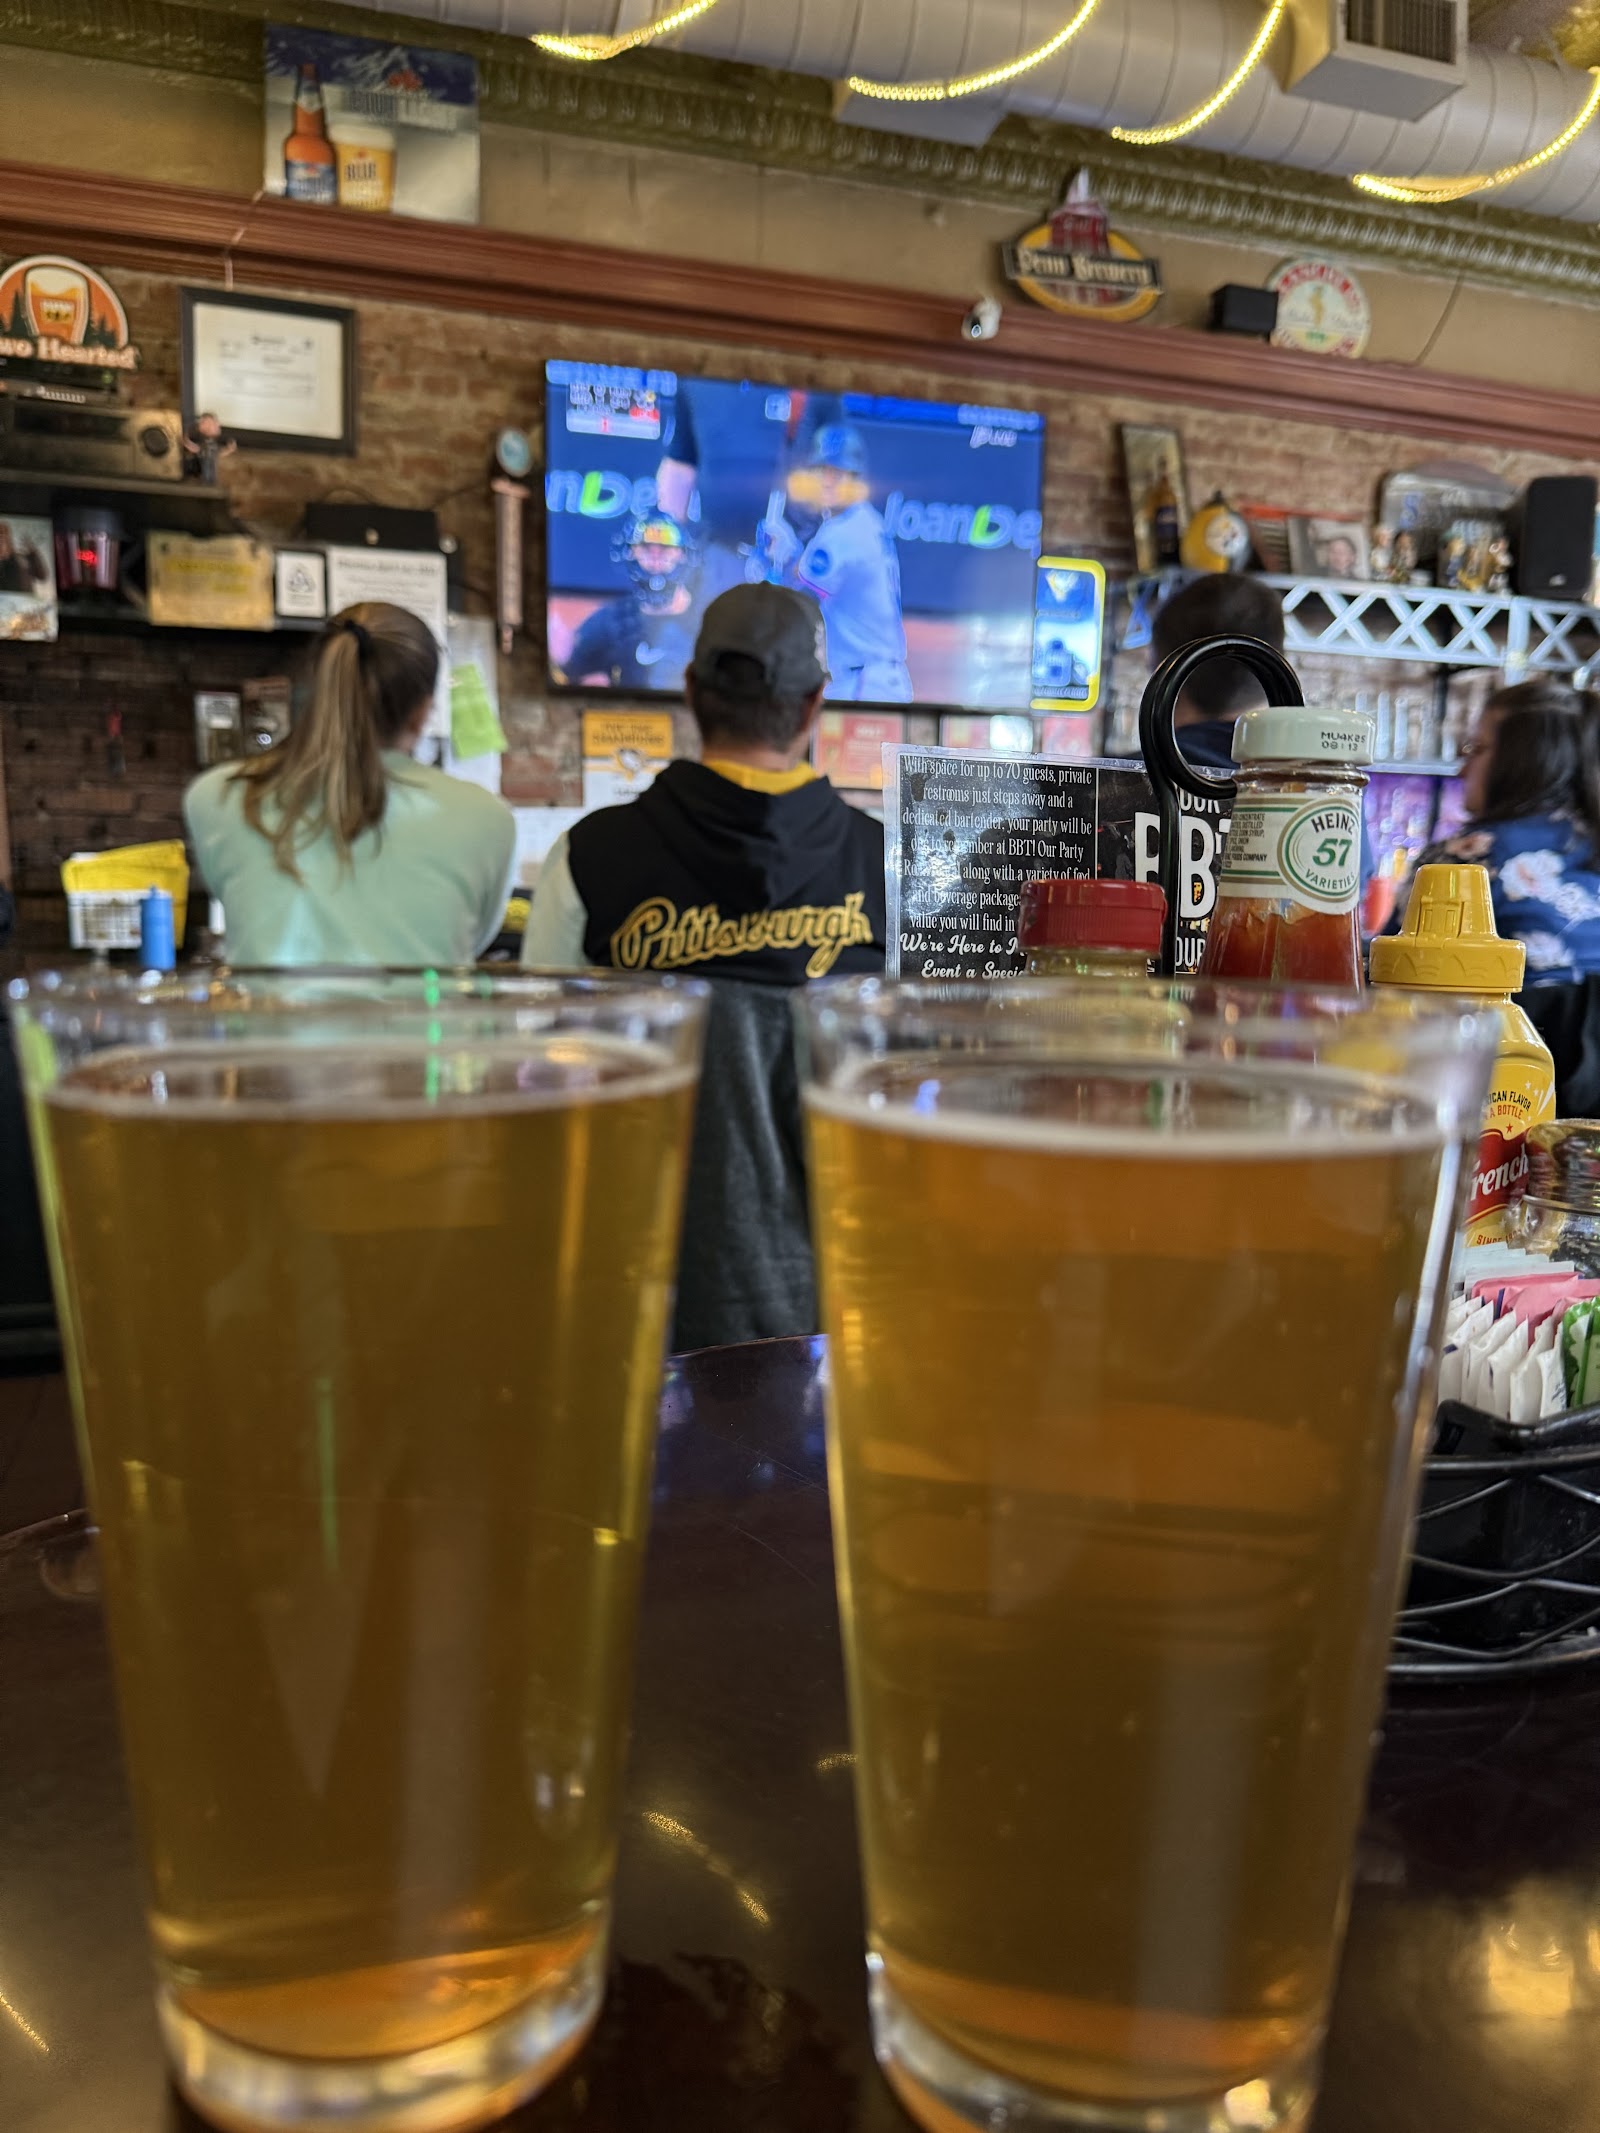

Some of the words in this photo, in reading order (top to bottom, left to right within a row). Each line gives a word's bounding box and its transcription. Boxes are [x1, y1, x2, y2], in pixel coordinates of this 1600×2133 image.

[37, 336, 139, 370] Hearted
[904, 756, 928, 774] With
[930, 761, 958, 779] space
[960, 760, 975, 777] for
[977, 764, 990, 782] up
[993, 763, 1003, 779] to
[1005, 763, 1020, 780] 70
[1023, 767, 1056, 784] guests,
[1058, 768, 1092, 786] private
[923, 784, 969, 803] restrooms
[971, 787, 991, 806] just
[993, 788, 1020, 807] steps
[1021, 793, 1046, 810] away
[1047, 790, 1065, 808] and
[1067, 796, 1073, 808] a
[903, 807, 951, 828] dedicated
[1007, 816, 1030, 835] your
[1032, 817, 1058, 836] party
[1060, 816, 1079, 834] will
[1081, 816, 1092, 835] be
[1311, 812, 1355, 835] HEINZ
[996, 840, 1006, 855] at
[1008, 838, 1036, 856] BBT!
[1038, 840, 1057, 857] Our
[1059, 841, 1084, 861] Party
[1312, 837, 1353, 867] 57
[963, 862, 990, 884] along
[993, 863, 1014, 881] with
[1017, 868, 1023, 881] a
[1026, 867, 1060, 881] variety
[1060, 866, 1071, 880] of
[1073, 867, 1091, 880] food
[1305, 868, 1355, 890] VARIETIES
[913, 886, 931, 903] and
[934, 887, 978, 909] beverage
[910, 912, 938, 929] value
[939, 916, 957, 932] you
[960, 913, 980, 931] will
[982, 913, 1003, 932] find
[1005, 915, 1015, 932] in
[611, 891, 873, 978] Pittsburgh
[900, 932, 945, 952] We're
[947, 934, 986, 956] Here
[989, 939, 1004, 954] to
[921, 958, 962, 979] Event
[965, 967, 977, 979] a
[1497, 1104, 1523, 1120] BOTTLE
[1509, 1091, 1532, 1112] FLAVOR
[1471, 1143, 1529, 1202] rench
